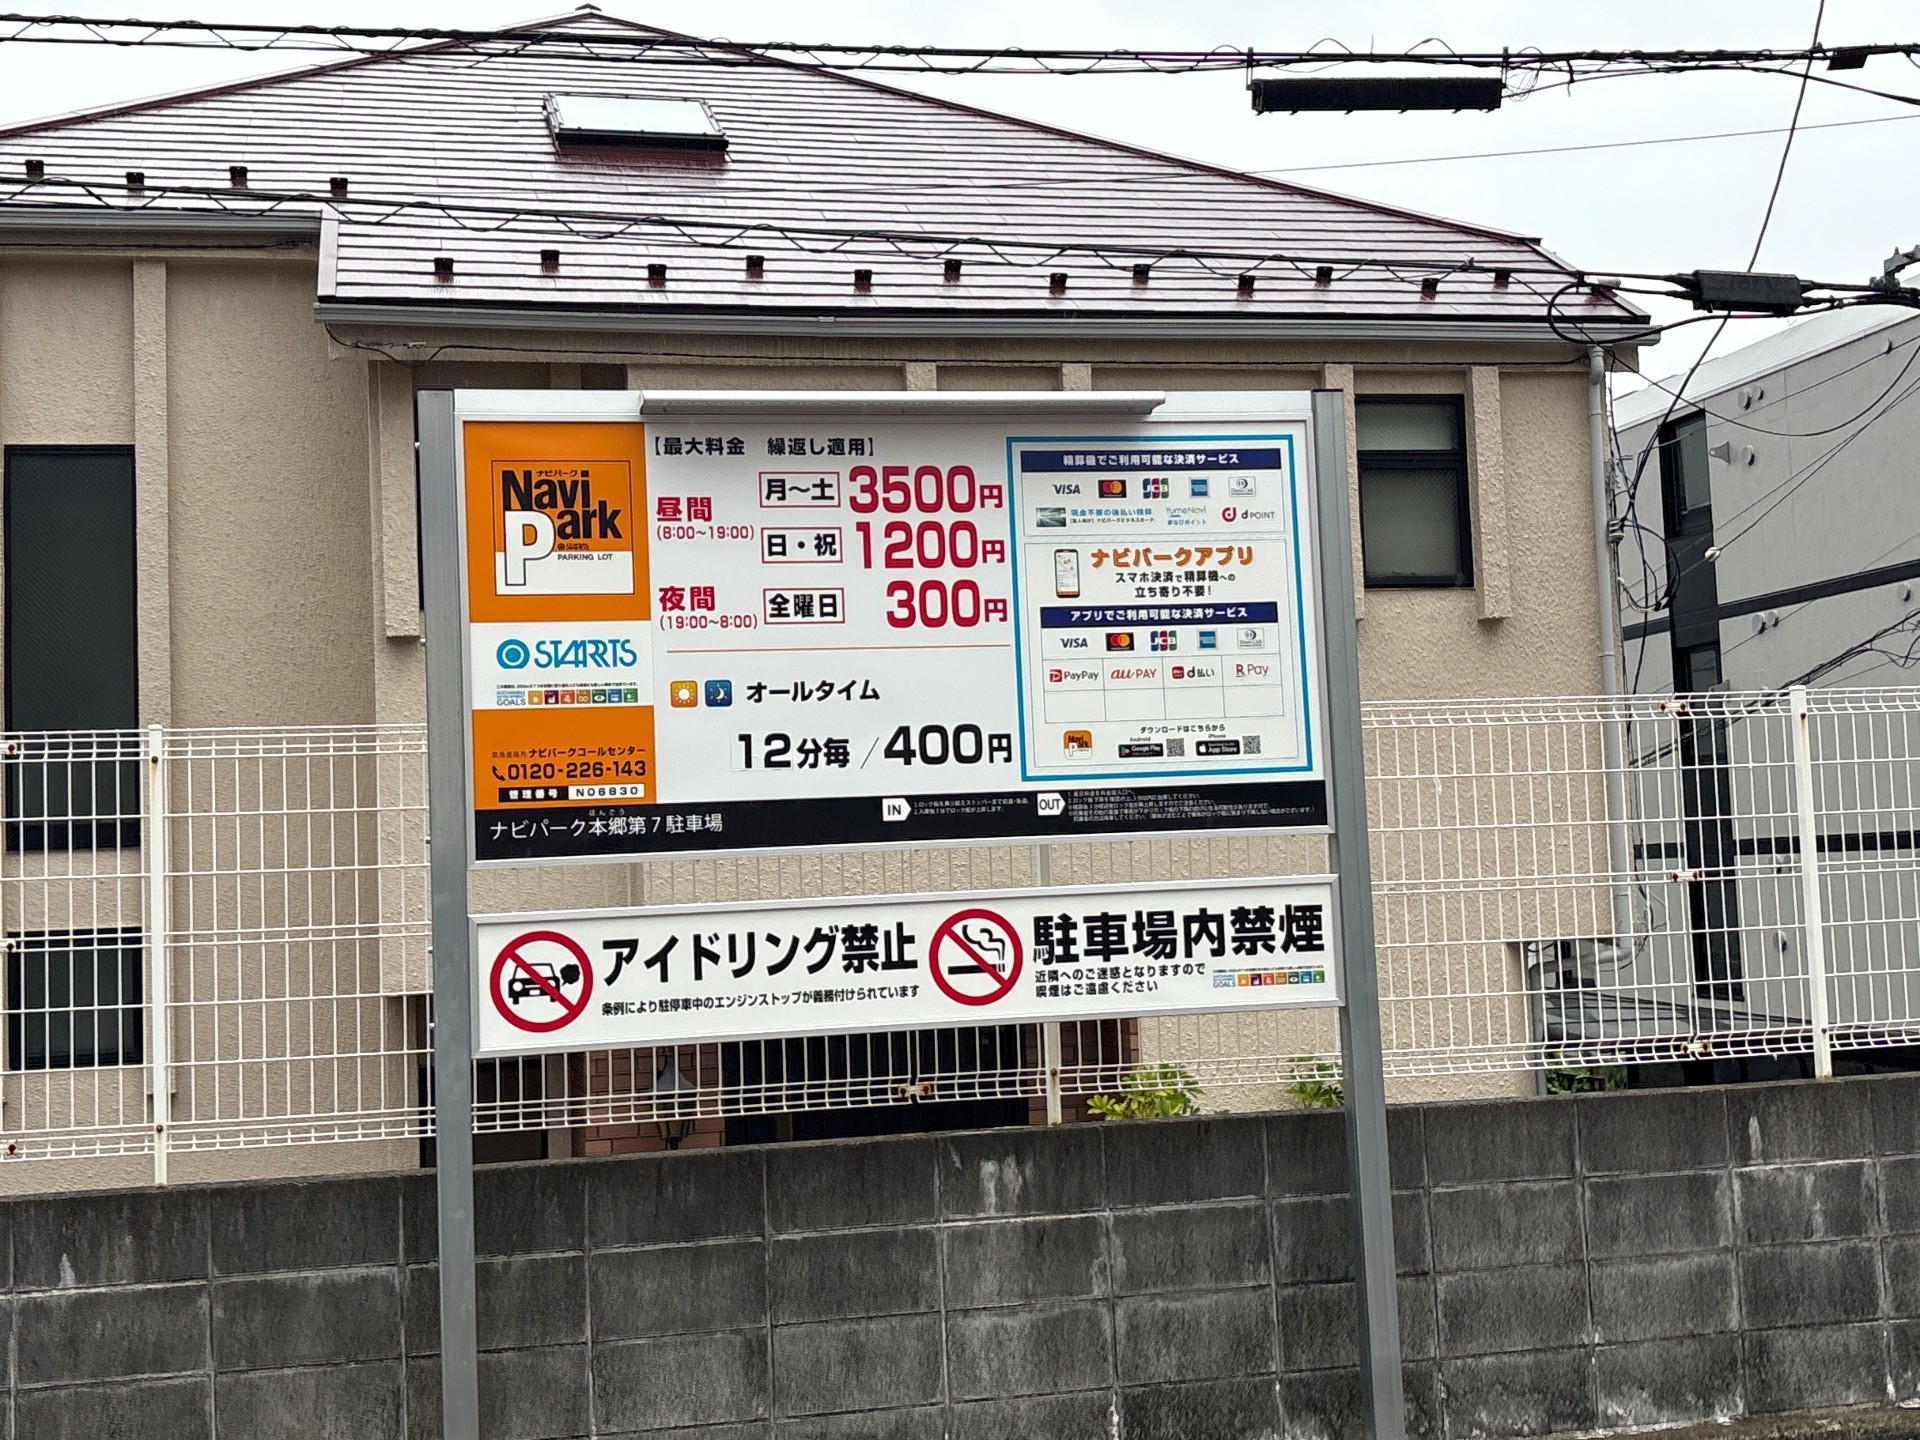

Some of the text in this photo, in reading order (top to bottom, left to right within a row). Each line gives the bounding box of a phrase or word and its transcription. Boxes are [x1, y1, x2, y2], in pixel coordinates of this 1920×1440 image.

[1062, 453, 1240, 466] 精算機でご利用可能な決済サービス
[501, 470, 591, 511] Navi
[764, 478, 836, 501] 月～土
[848, 465, 1003, 514] 3500円
[1052, 480, 1170, 496] VISA JCB
[655, 496, 713, 523] 昼間
[1250, 511, 1276, 519] POINT
[656, 525, 755, 540] (8:00~19:00)
[504, 500, 622, 586] Park
[766, 533, 837, 557] 日・祝
[855, 521, 1006, 569] 1200円
[557, 553, 613, 561] PARKING LOT
[1090, 545, 1255, 568] ナビパークアプリ
[1115, 570, 1236, 584] スマホ決済で精算機への
[658, 586, 716, 612] 夜間
[768, 593, 838, 619] 全曜日
[886, 579, 1009, 628] 300円
[659, 613, 759, 630] (19:00~8:00)
[1069, 607, 1249, 622] アプリでご利用可能な決済サービス
[1059, 632, 1178, 648] VISA JCB
[1063, 670, 1099, 681] PayPay
[1135, 668, 1157, 679] PAY
[1247, 664, 1269, 676] Pay
[746, 679, 881, 703] オールタイム
[497, 697, 527, 706] GOALS
[1139, 723, 1226, 734] ダウンロードはこちらから
[528, 745, 646, 759] ナビパークコールセンター
[1131, 745, 1150, 753] Google
[507, 759, 647, 781] 0120-226-143
[887, 804, 902, 816] IN
[1038, 799, 1062, 812] OUT
[1032, 903, 1326, 966] 駐車場内禁煙
[601, 921, 919, 987] アイドリング禁止
[1034, 963, 1206, 984] 近隣へのご迷惑となりますので
[1035, 980, 1159, 998] 喫煙はご遠慮ください
[601, 984, 920, 1016] 条例により駐停車中のエンジンストップが義務付けられています
